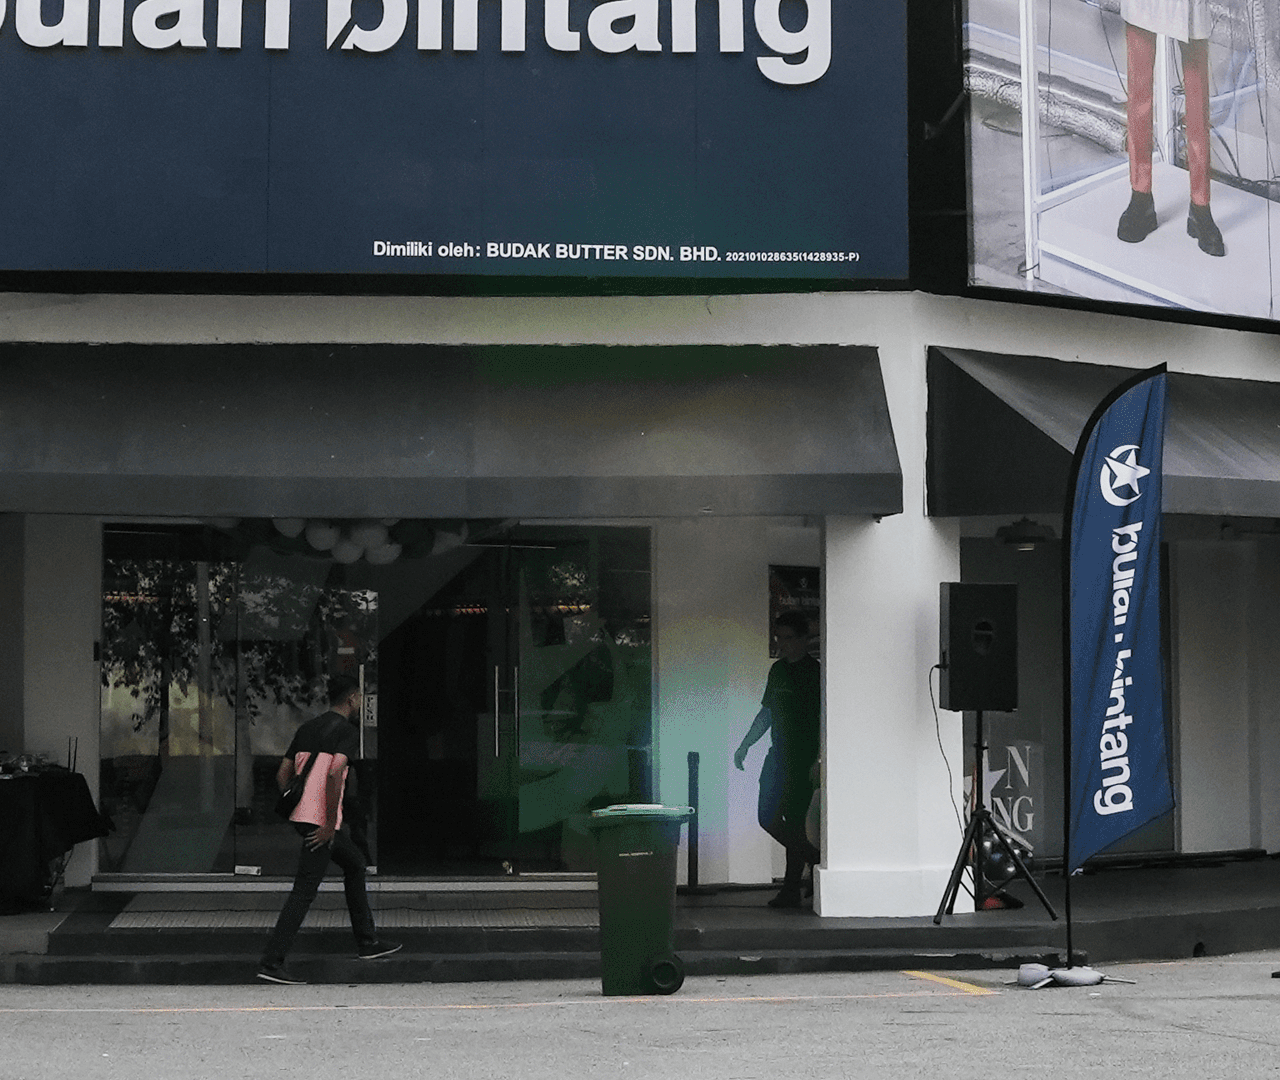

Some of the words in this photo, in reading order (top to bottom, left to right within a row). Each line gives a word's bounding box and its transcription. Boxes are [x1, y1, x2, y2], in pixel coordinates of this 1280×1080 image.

[373, 240, 433, 256] Dimiliki
[437, 241, 481, 257] oleh:
[486, 242, 551, 258] BUDAK
[555, 243, 628, 260] BUTTER
[632, 245, 675, 261] SDN.
[679, 246, 722, 262] BHD.
